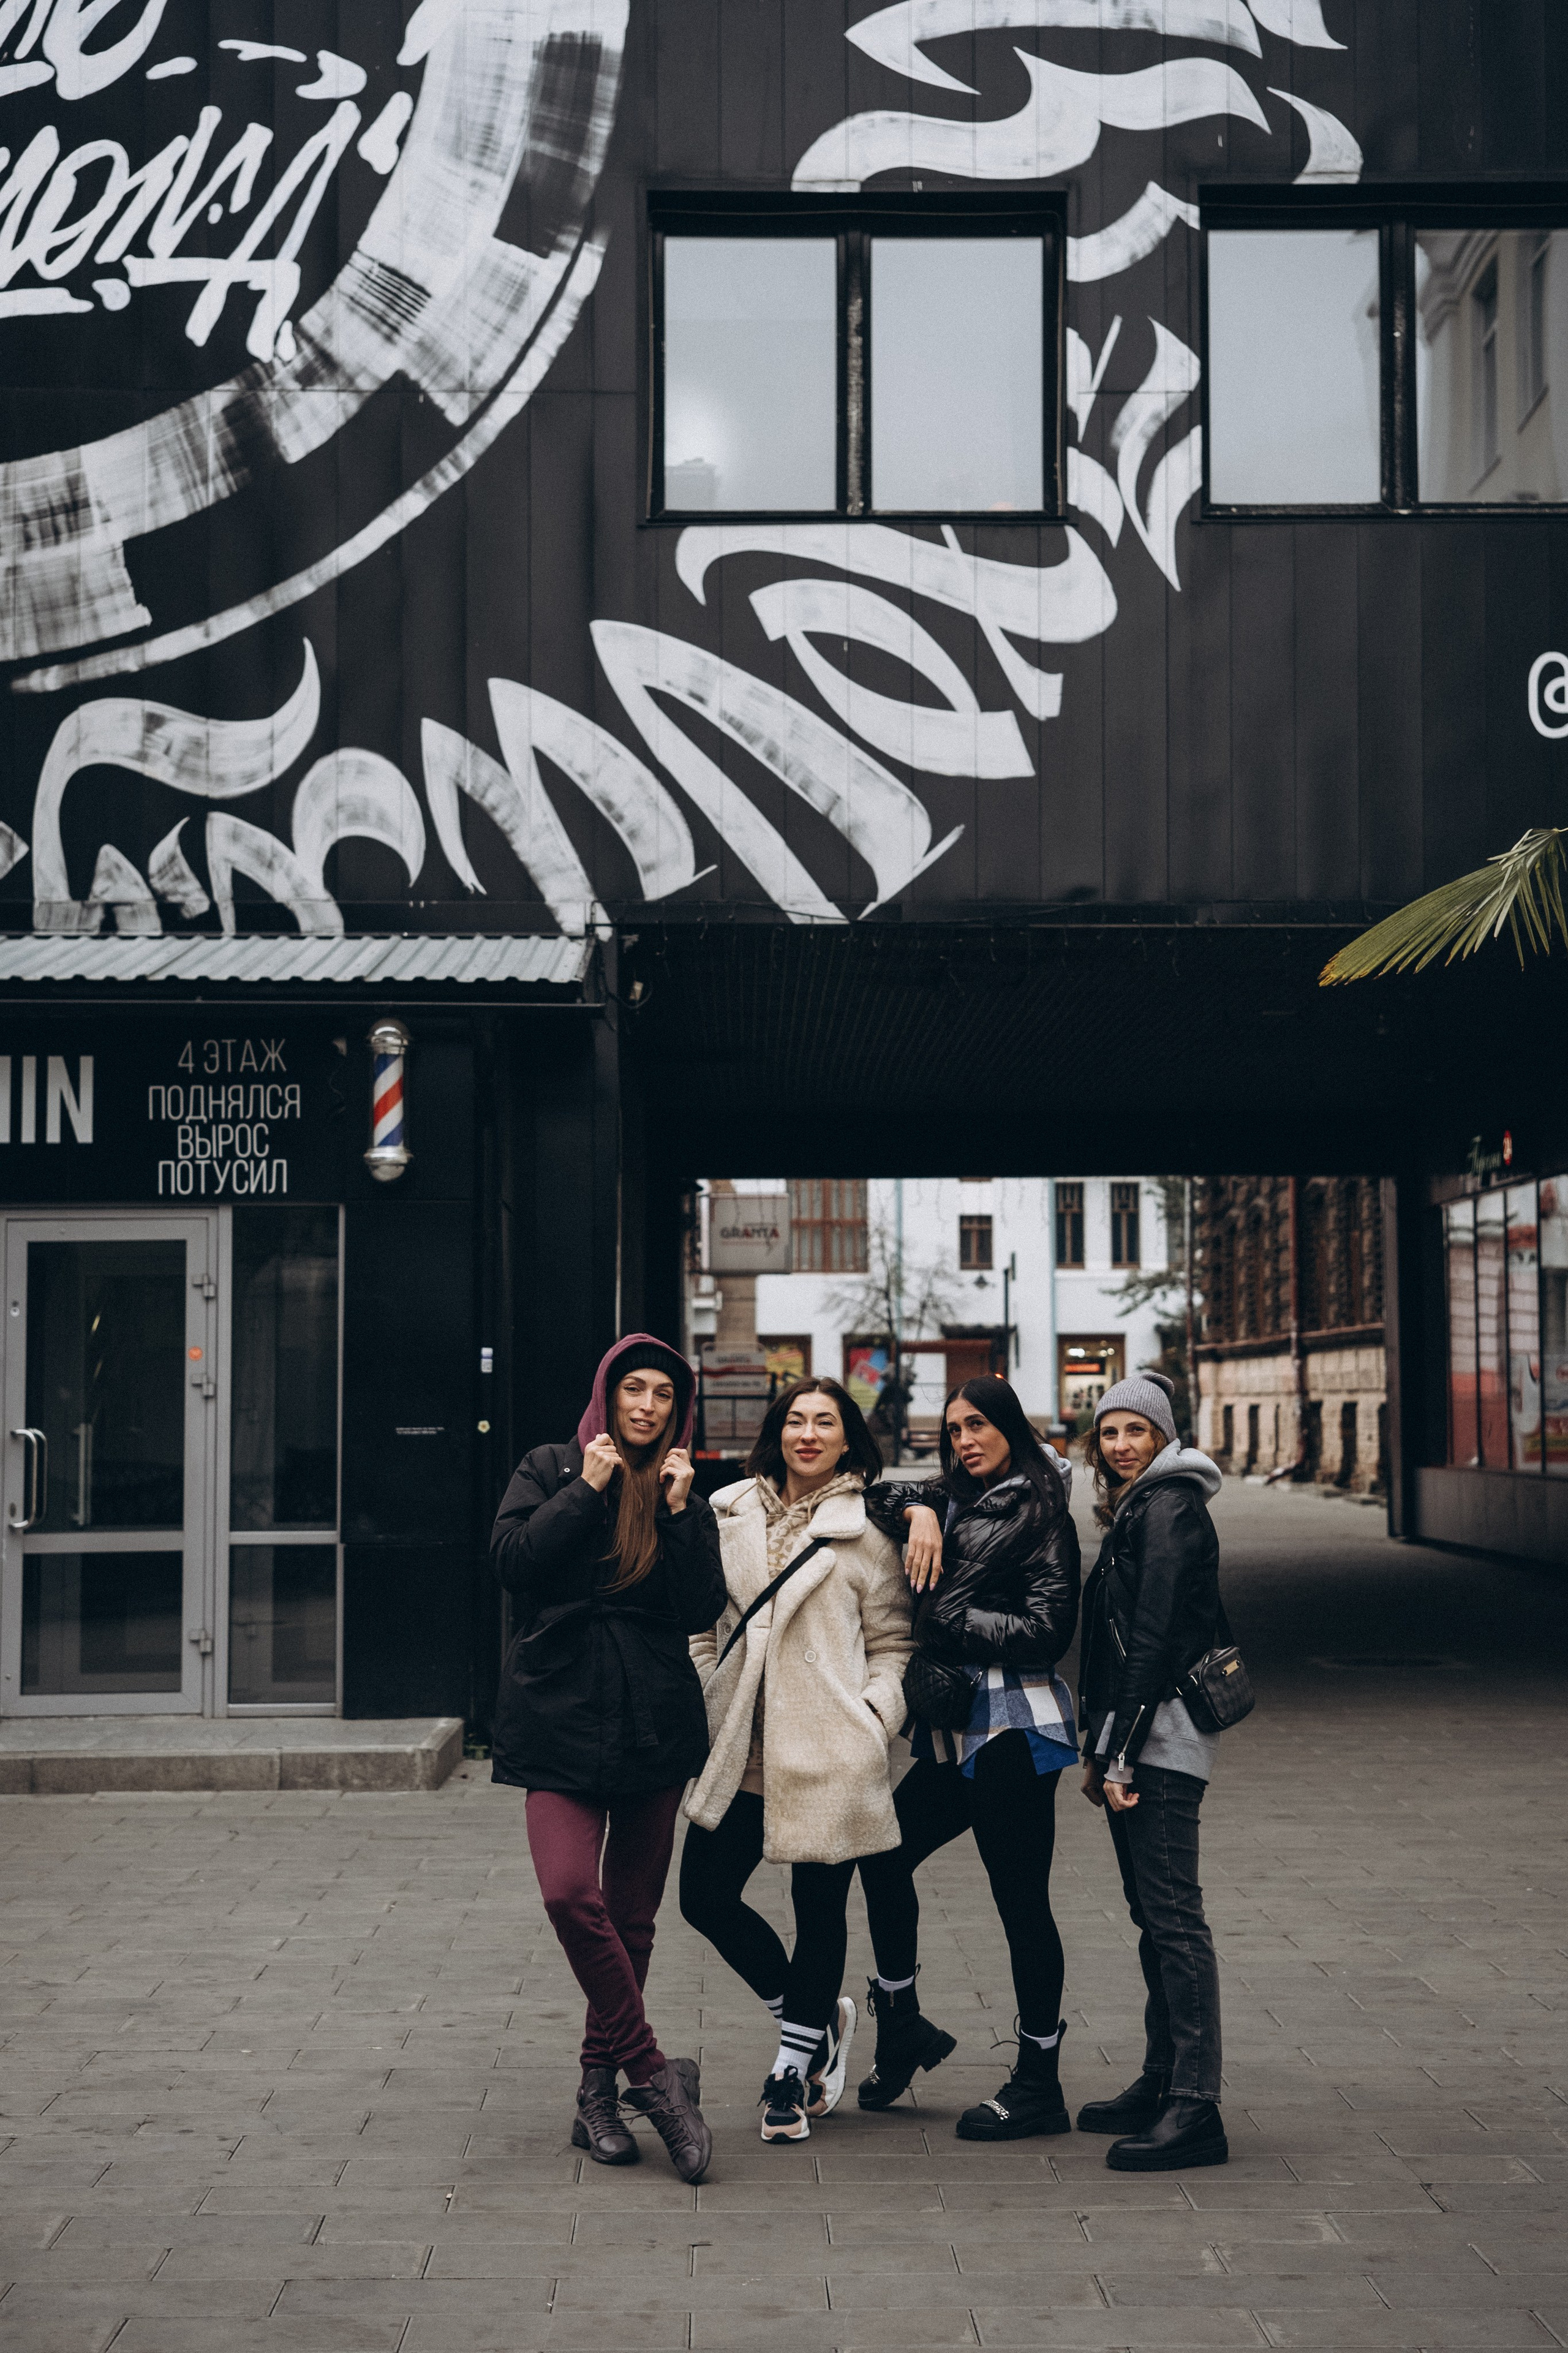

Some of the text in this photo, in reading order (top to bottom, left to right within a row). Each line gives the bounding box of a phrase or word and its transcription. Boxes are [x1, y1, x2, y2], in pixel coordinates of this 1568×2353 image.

[178, 1038, 287, 1073] 4 ЭТАЖ
[148, 1084, 301, 1124] ПОДНЯЛСЯ
[177, 1123, 270, 1159] ВЫРОС
[158, 1159, 287, 1195] ПОТУСИЛ
